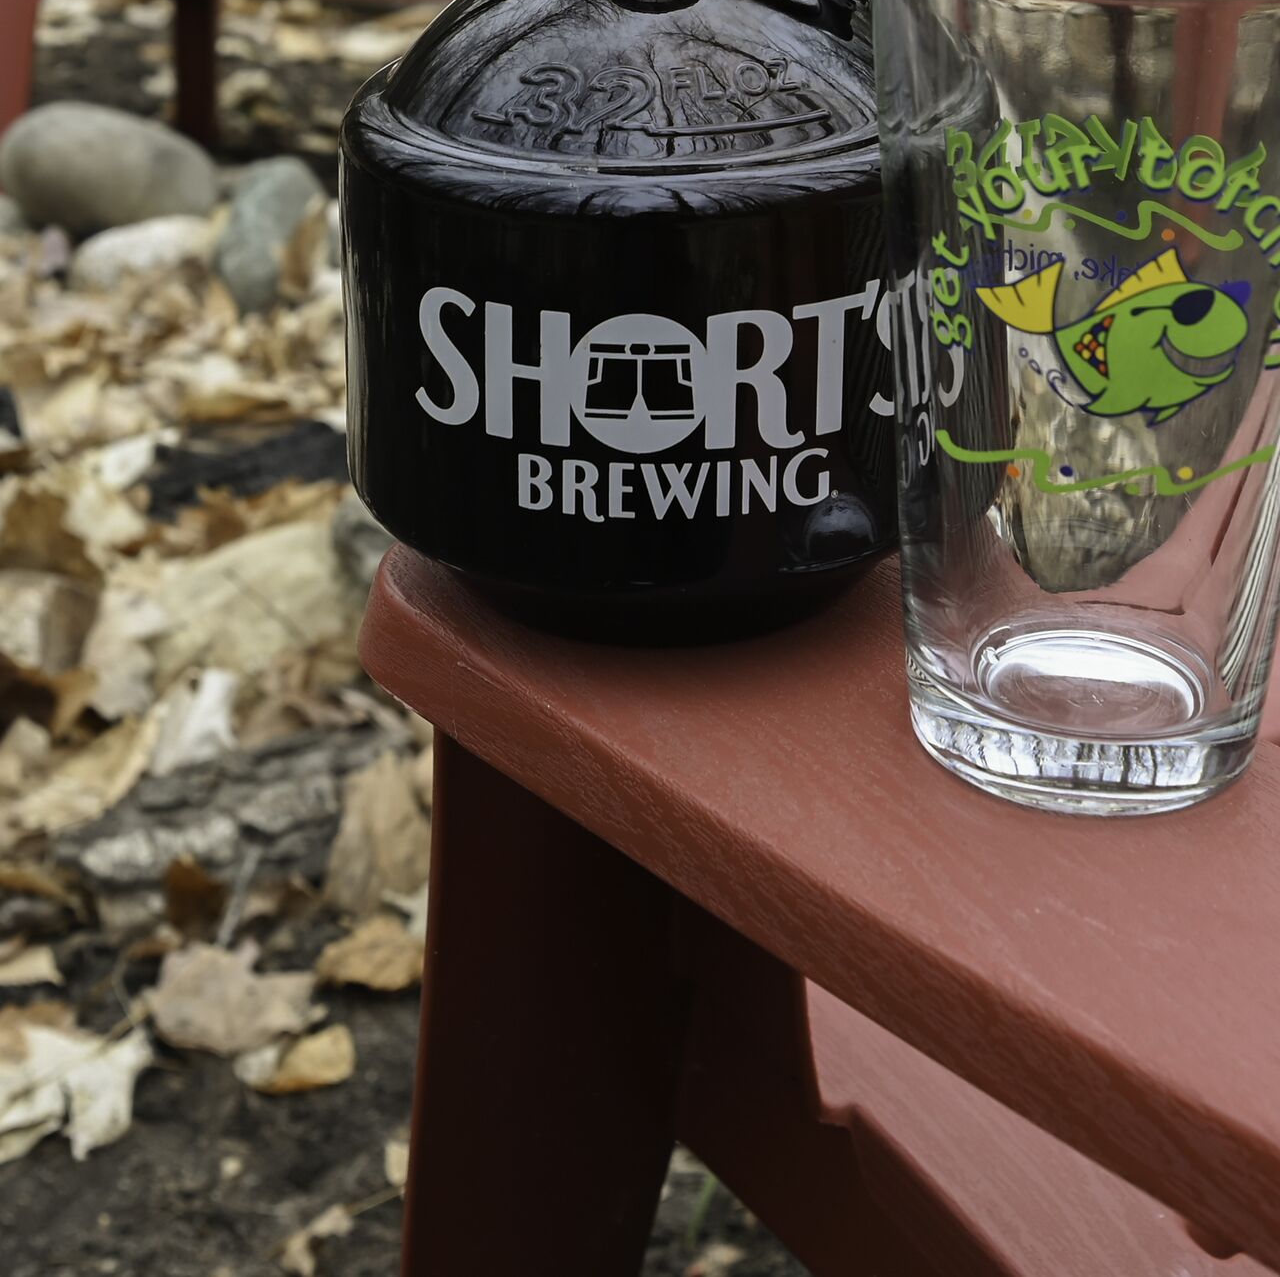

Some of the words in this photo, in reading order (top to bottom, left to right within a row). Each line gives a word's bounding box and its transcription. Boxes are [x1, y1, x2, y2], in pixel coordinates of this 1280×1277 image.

[520, 61, 656, 135] 32
[930, 229, 974, 352] get
[958, 143, 1103, 241] your
